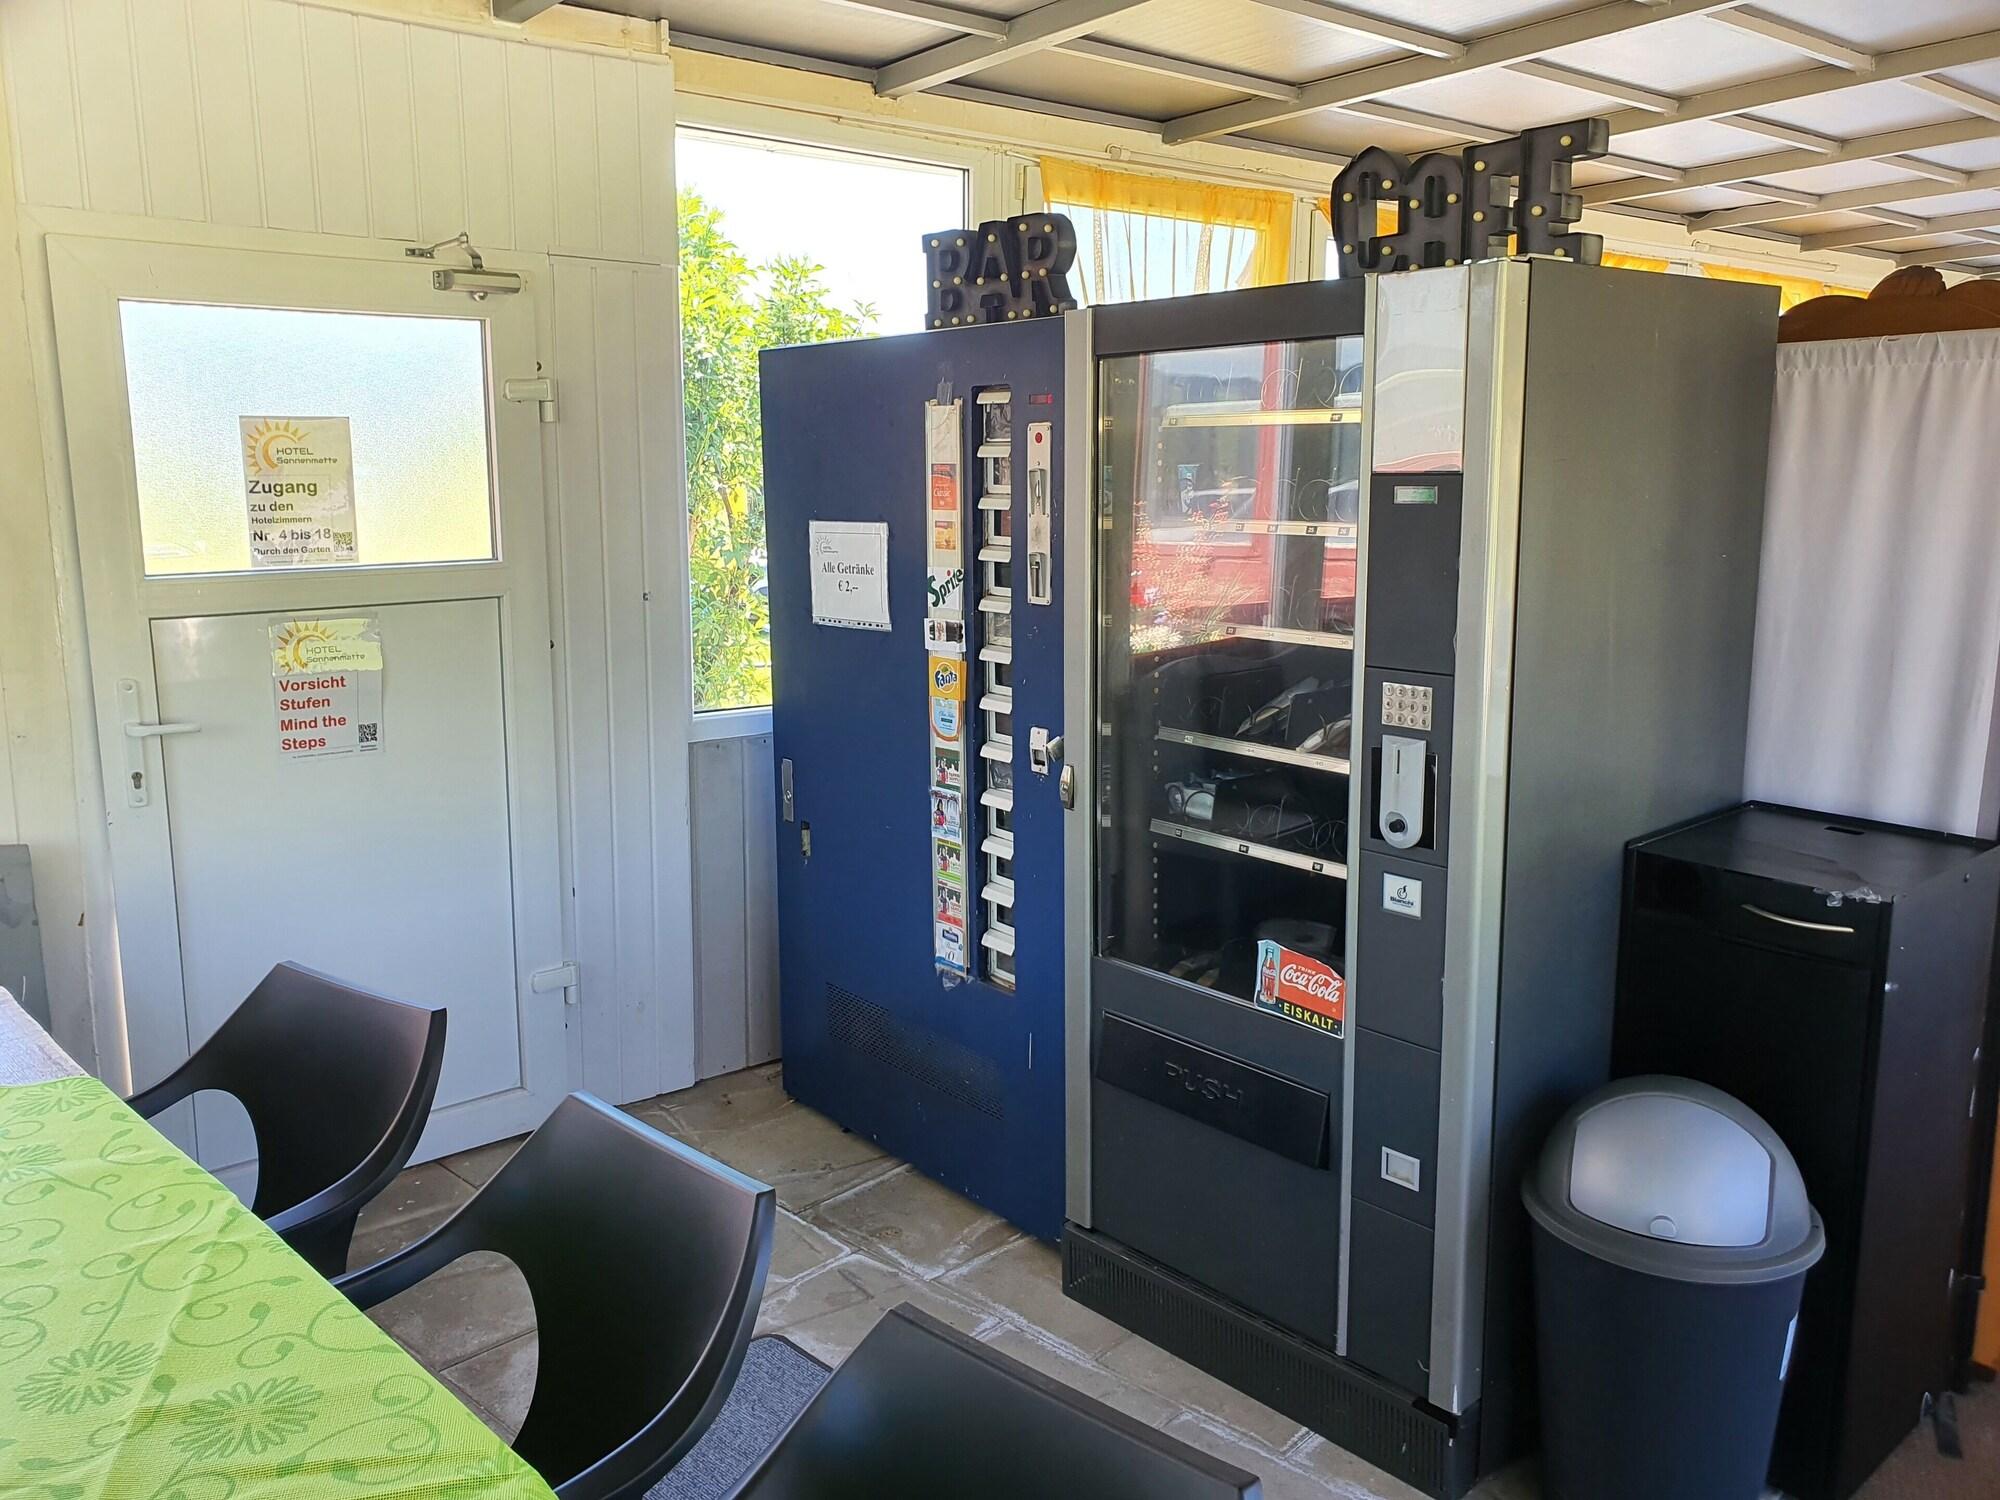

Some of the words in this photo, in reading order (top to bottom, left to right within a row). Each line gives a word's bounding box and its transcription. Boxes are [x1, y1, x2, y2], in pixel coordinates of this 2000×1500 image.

[922, 213, 1077, 330] BAR
[276, 447, 314, 456] HOTEL
[248, 480, 318, 497] Zugang
[250, 503, 266, 512] zu
[269, 501, 294, 512] den
[251, 516, 312, 525] Hotelzimmern
[253, 530, 275, 542] Nr.
[279, 530, 287, 541] 4
[291, 529, 311, 540] bis
[315, 528, 331, 539] 18
[282, 546, 299, 555] den
[301, 545, 331, 554] Garten
[821, 562, 836, 573] Alle
[837, 562, 875, 576] Getränke
[838, 580, 843, 592] €
[927, 568, 964, 608] Sprite
[306, 646, 342, 655] HOTEL
[279, 675, 346, 692] Vorsicht
[934, 669, 958, 688] Fanta
[280, 697, 331, 711] Stufen
[280, 716, 318, 732] Mind
[322, 715, 347, 728] the
[281, 737, 327, 751] Steps
[1280, 964, 1342, 1003] Coca-Cola
[1283, 1003, 1334, 1030] EISKALT
[1165, 1060, 1244, 1104] PUSH
